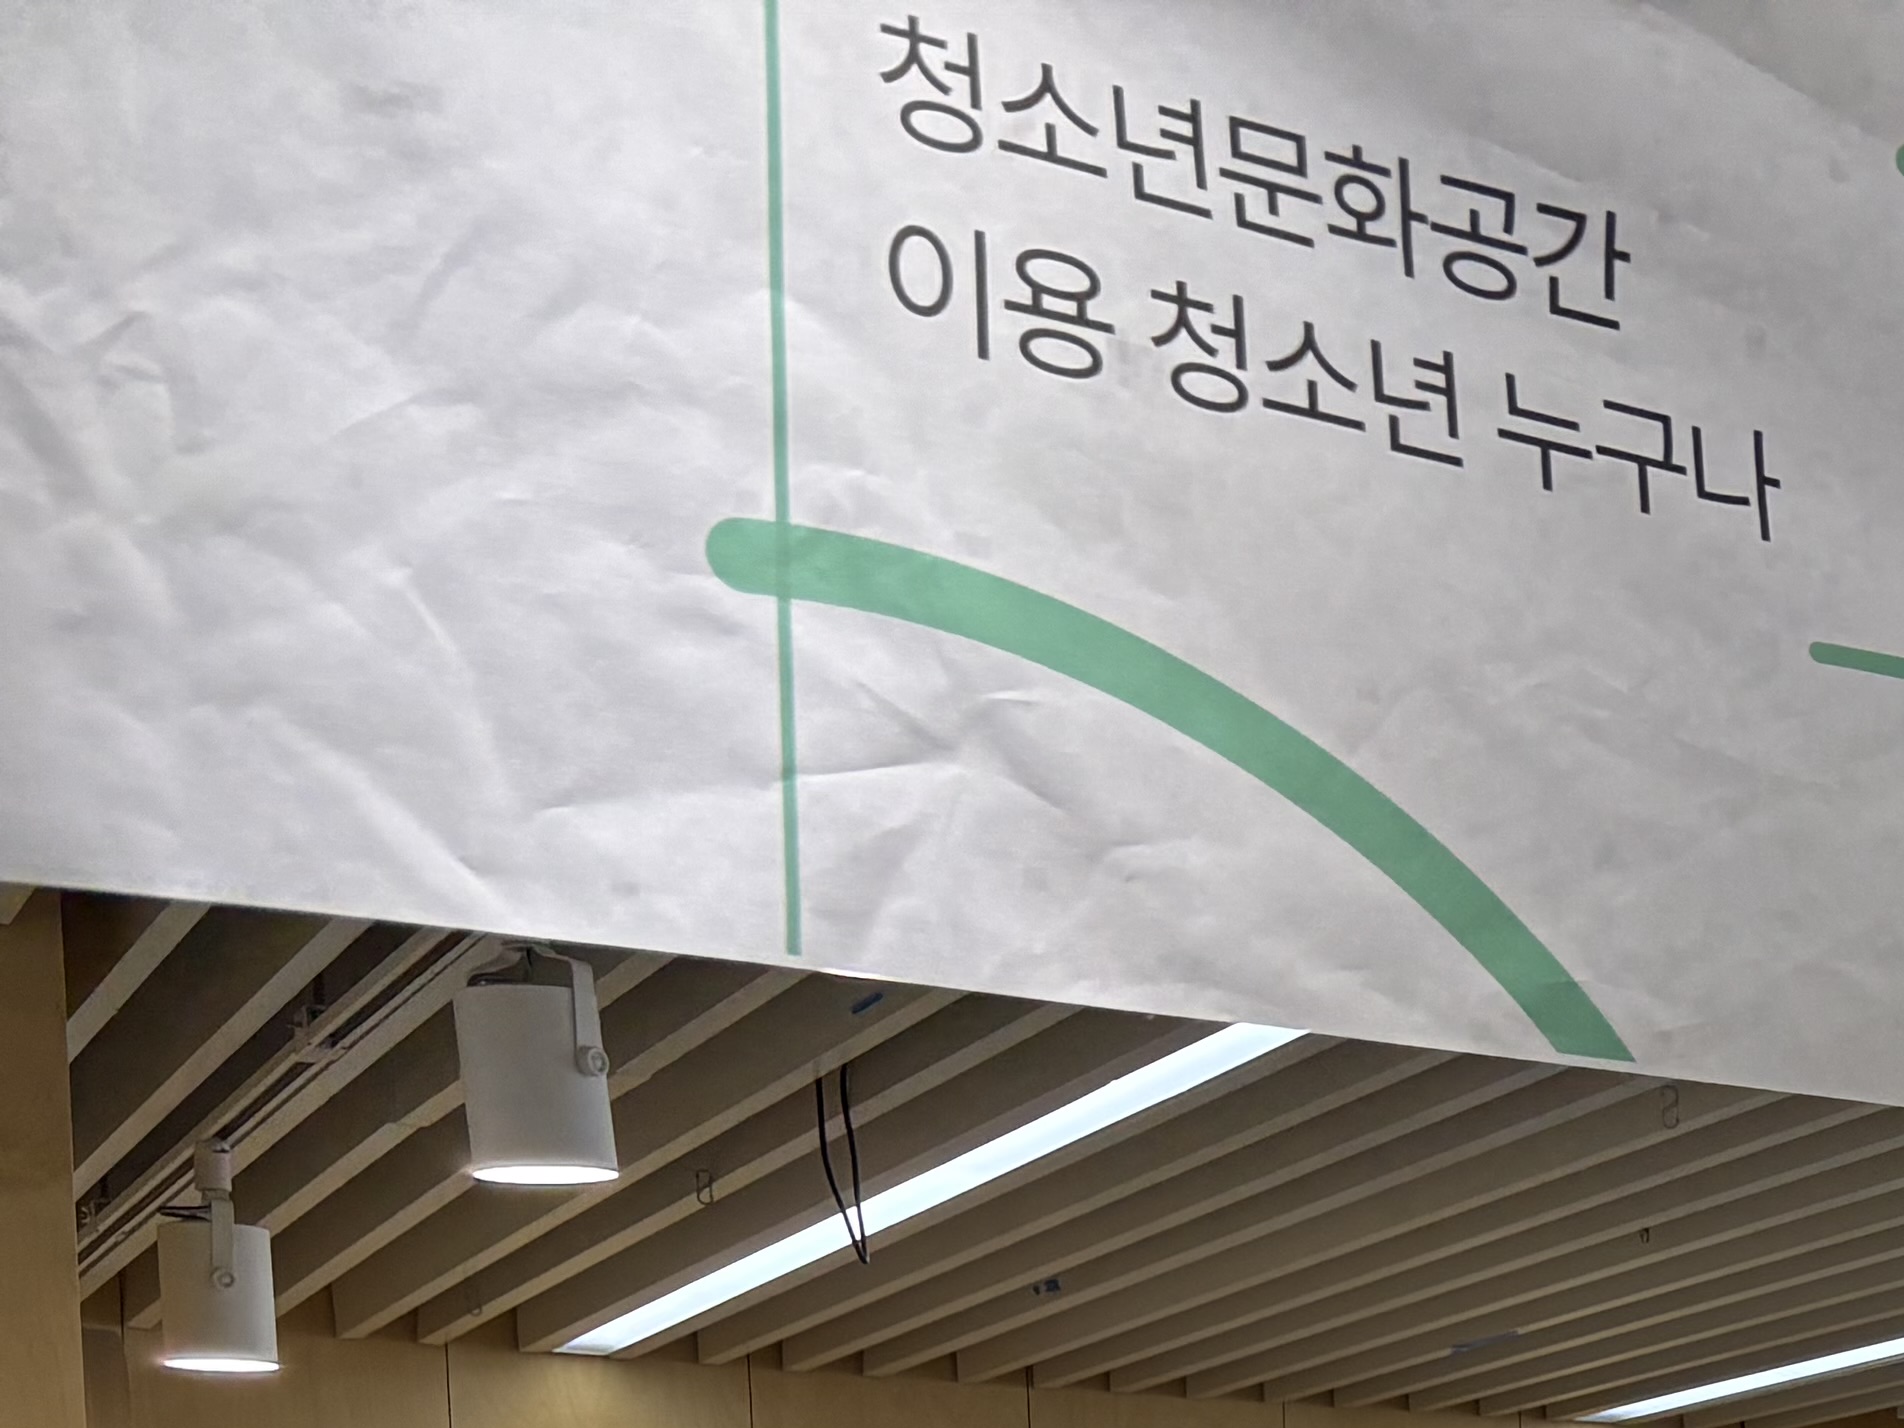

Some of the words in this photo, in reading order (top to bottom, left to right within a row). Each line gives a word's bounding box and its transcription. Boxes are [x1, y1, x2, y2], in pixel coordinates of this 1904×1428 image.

[879, 14, 1631, 331] 청소년문화공간
[887, 224, 1116, 381] 이용
[1150, 279, 1465, 468] 청소년
[1496, 372, 1781, 542] 누구나
